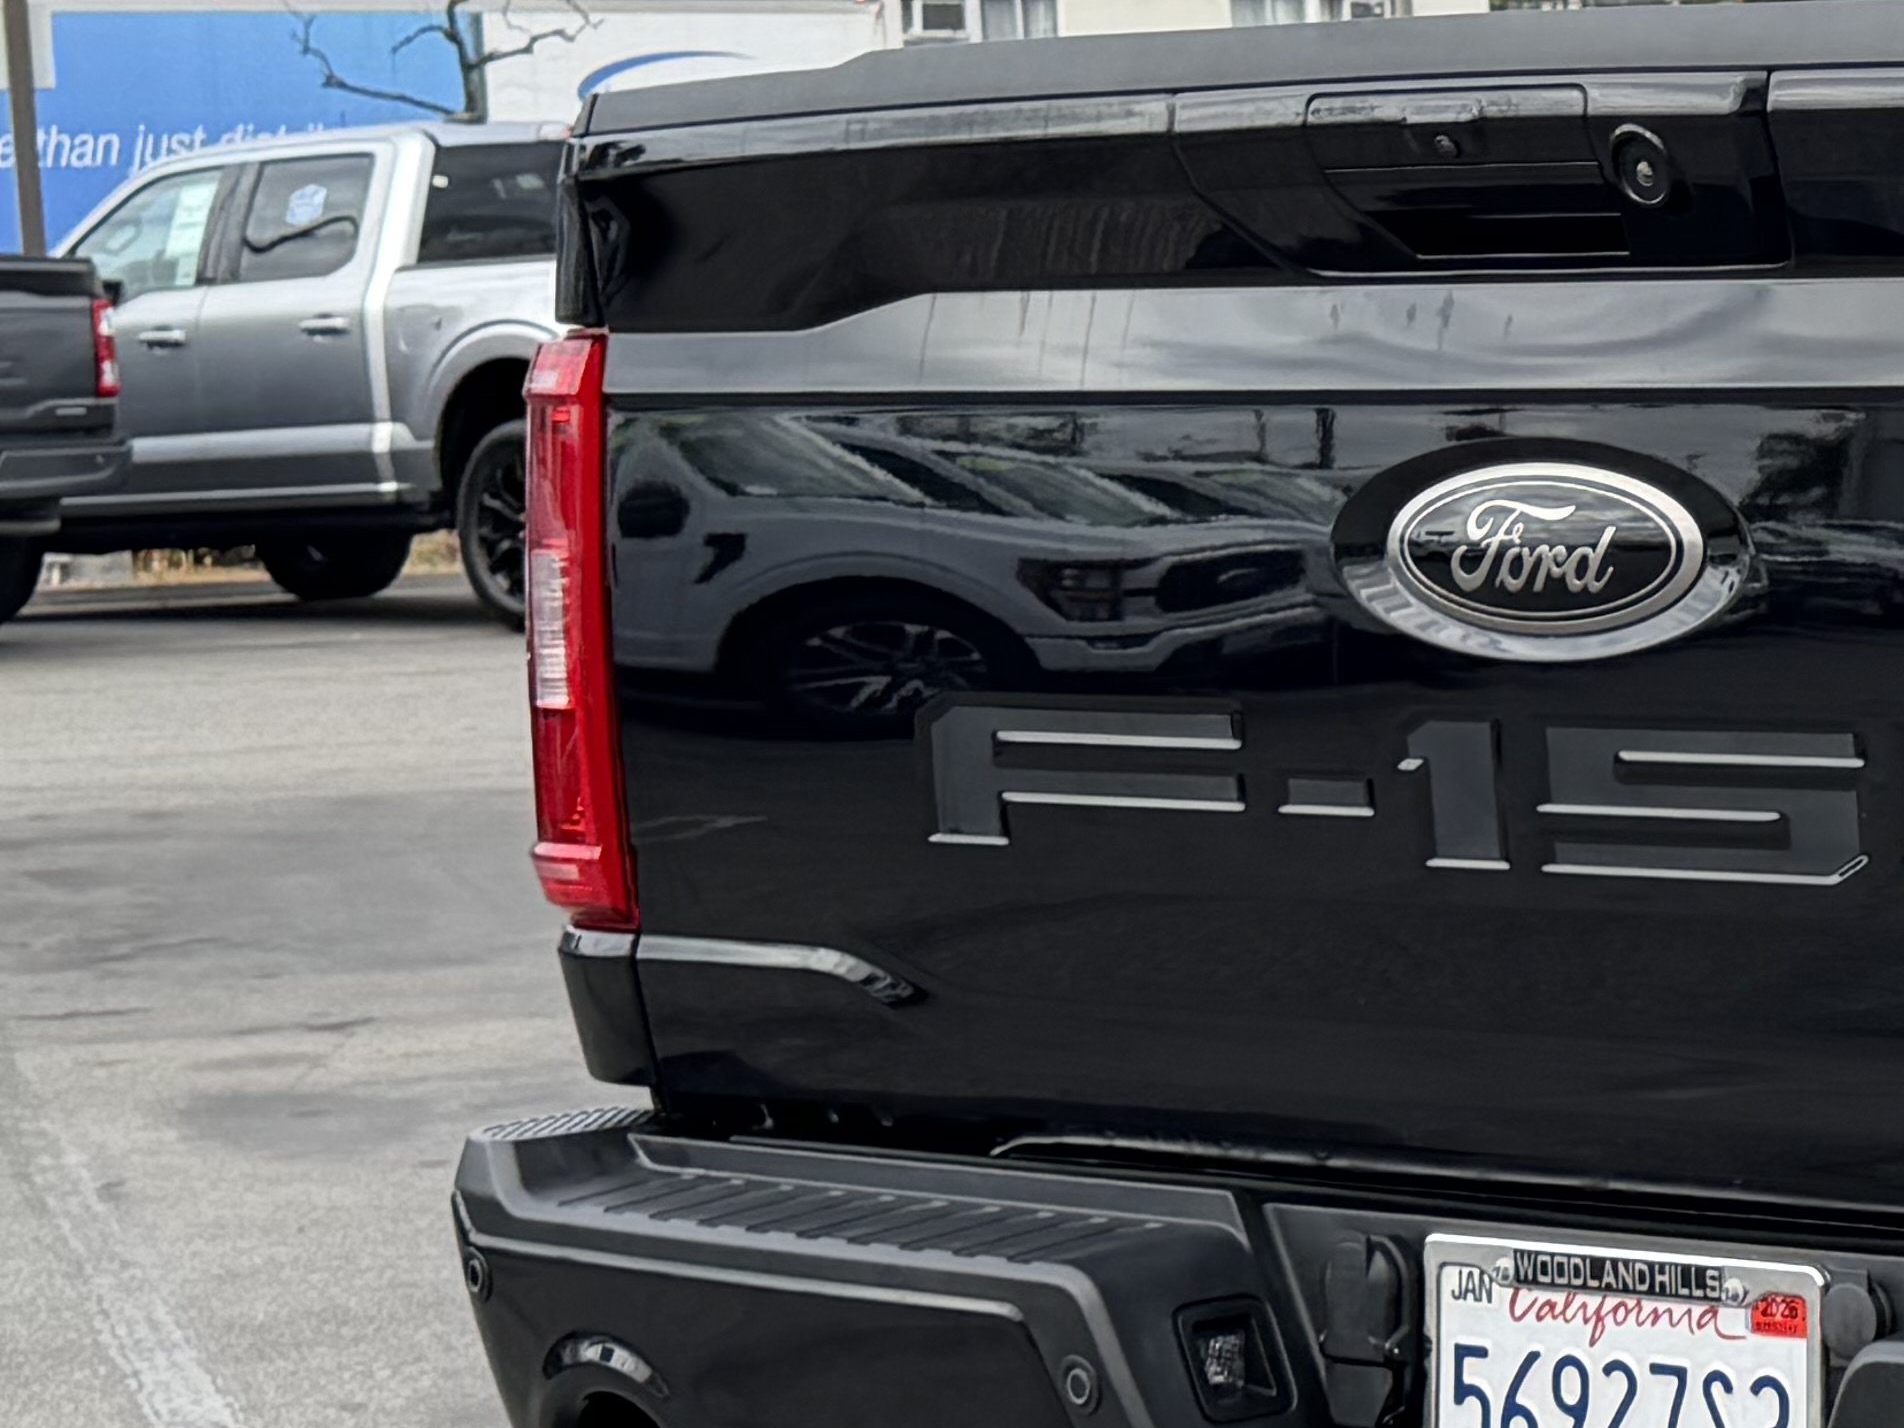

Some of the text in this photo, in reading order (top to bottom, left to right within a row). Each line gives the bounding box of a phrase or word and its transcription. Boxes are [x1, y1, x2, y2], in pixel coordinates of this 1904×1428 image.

[1450, 499, 1617, 595] Ford
[1450, 1268, 1493, 1304] JAN
[1515, 1250, 1721, 1299] WOODLAND HILLS
[1508, 1287, 1747, 1348] California
[1760, 1297, 1799, 1320] 2026
